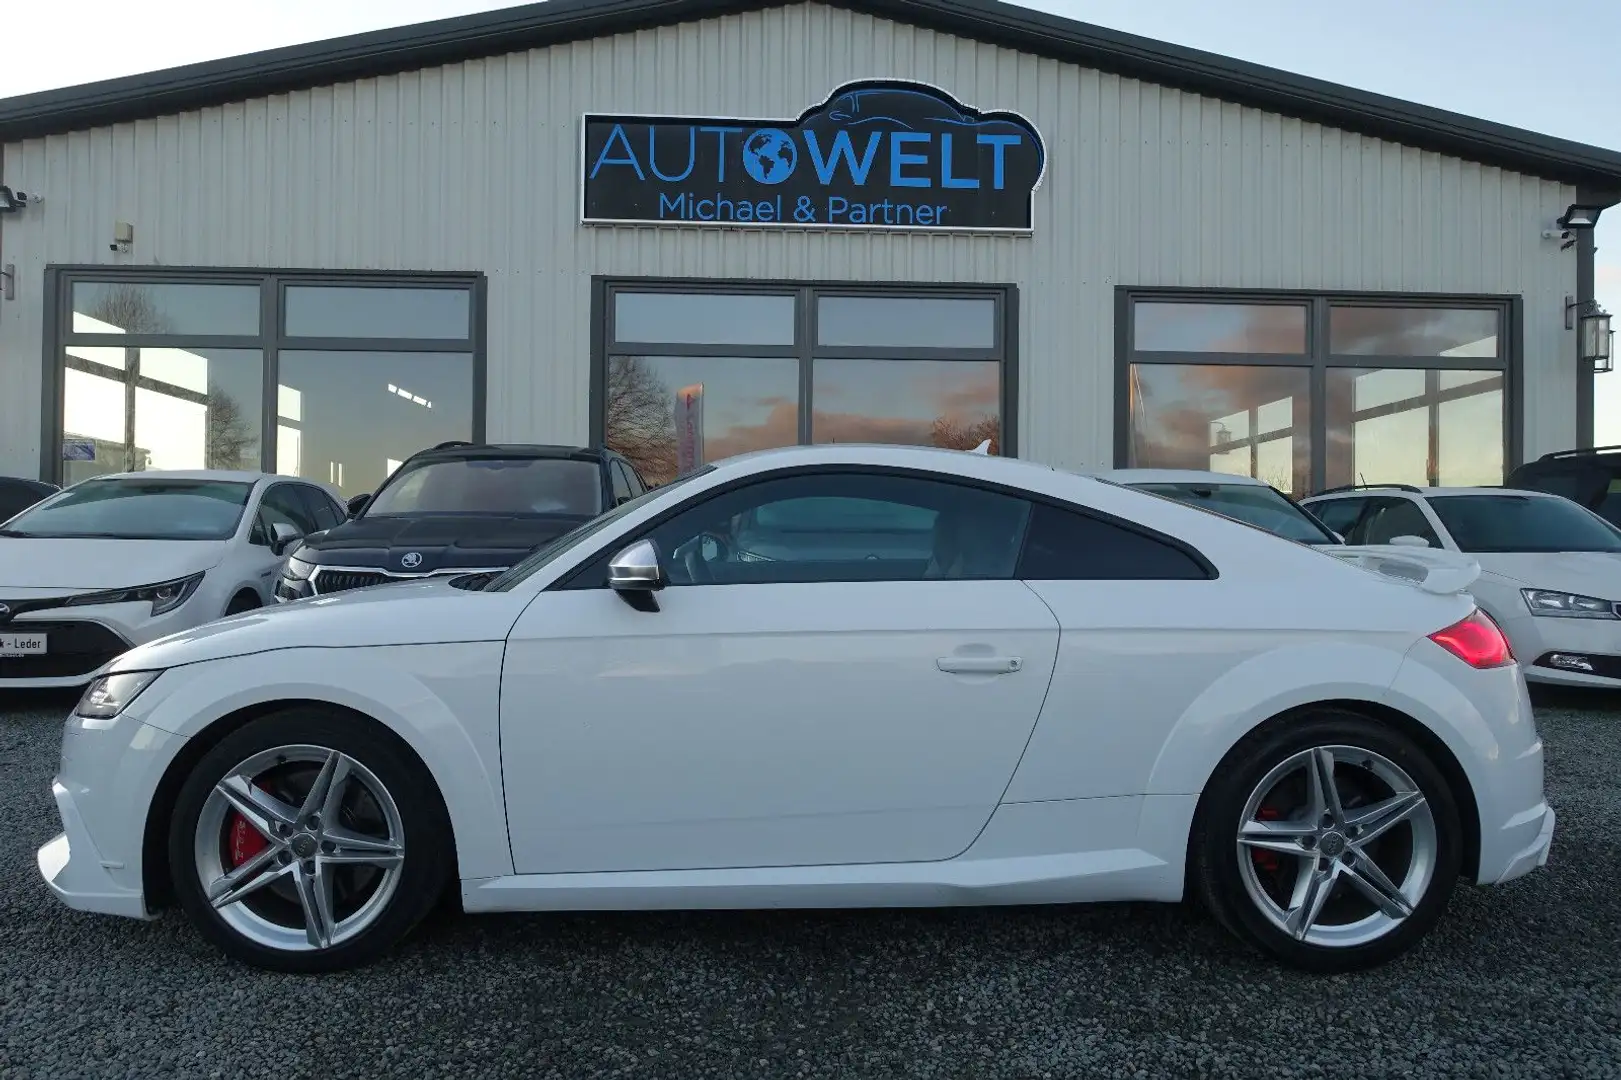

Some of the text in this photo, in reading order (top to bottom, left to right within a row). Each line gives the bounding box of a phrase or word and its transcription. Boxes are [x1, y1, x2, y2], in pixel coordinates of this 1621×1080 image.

[659, 192, 947, 225] Michael & Partner
[14, 637, 42, 649] Leder
